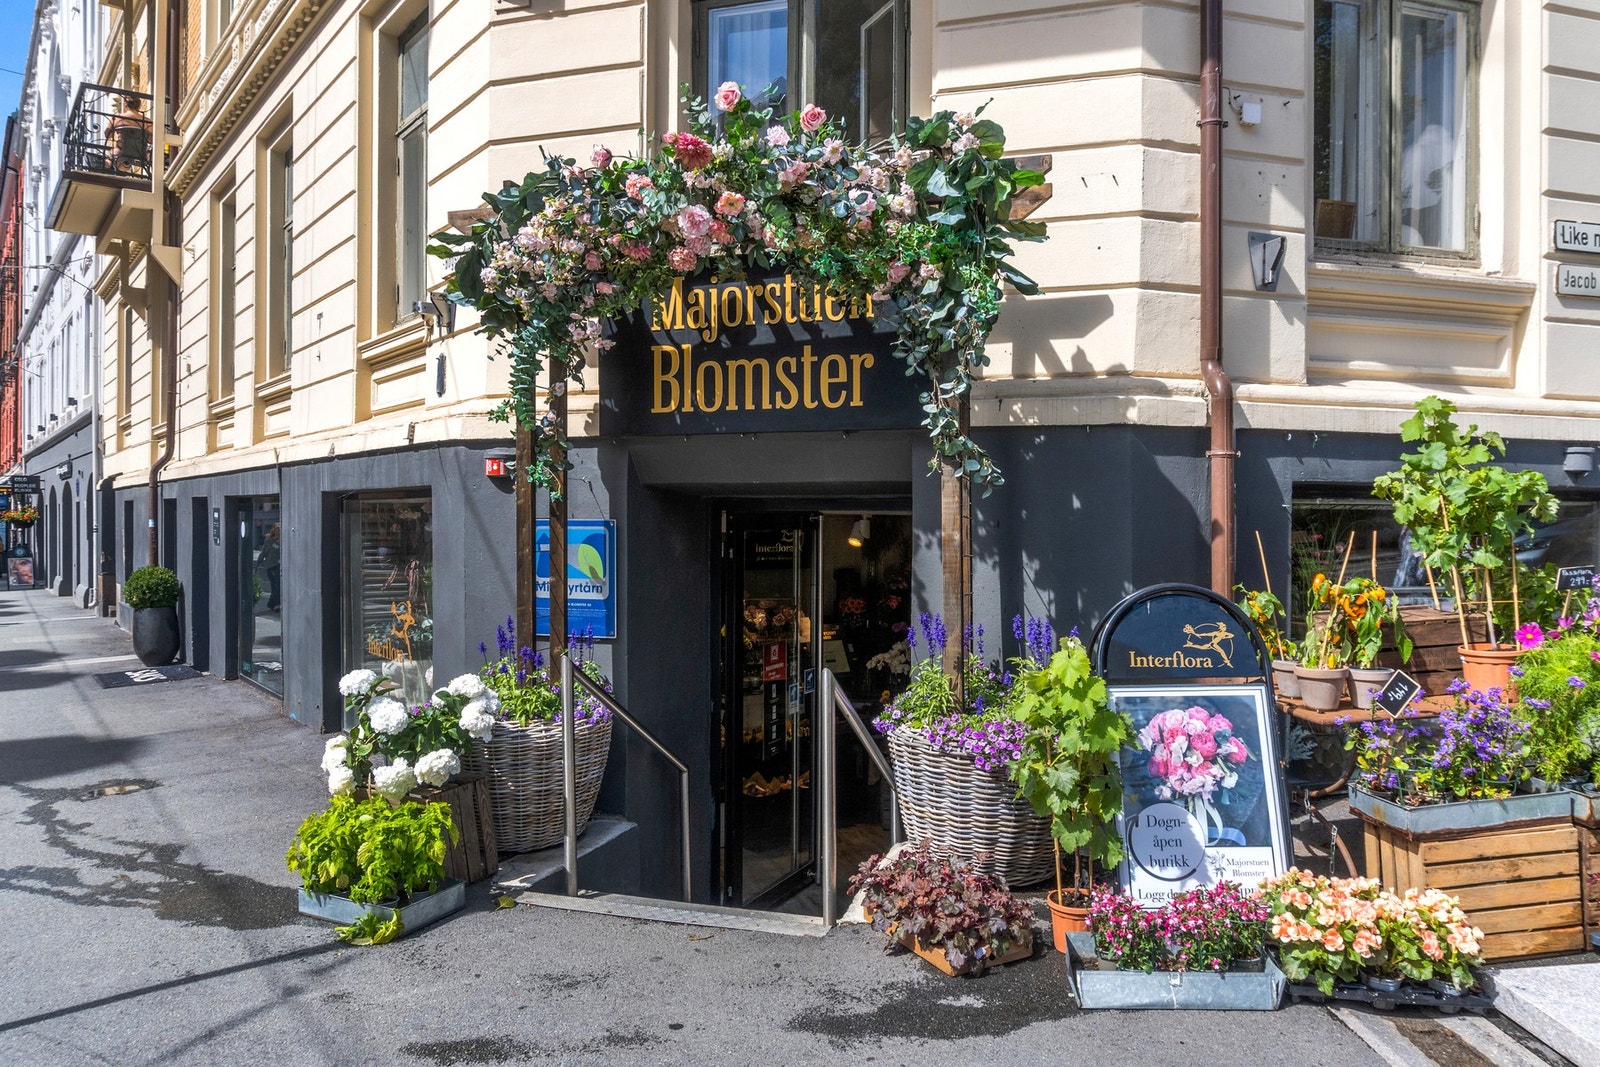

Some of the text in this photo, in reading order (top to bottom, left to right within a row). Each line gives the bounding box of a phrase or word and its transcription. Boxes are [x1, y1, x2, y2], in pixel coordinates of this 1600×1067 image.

[1560, 225, 1589, 246] Like
[1564, 270, 1597, 289] Jacob
[651, 344, 875, 413] Blomster
[755, 542, 794, 553] Interflora
[535, 581, 603, 596] Miyrtårn
[1129, 651, 1213, 668] Interflora
[1146, 815, 1186, 832] Døgn-
[1153, 835, 1183, 851] åpen
[1149, 854, 1190, 868] butikk
[1226, 858, 1269, 868] Majorstuen
[1232, 869, 1266, 877] Blomster
[1138, 888, 1165, 903] Logg
